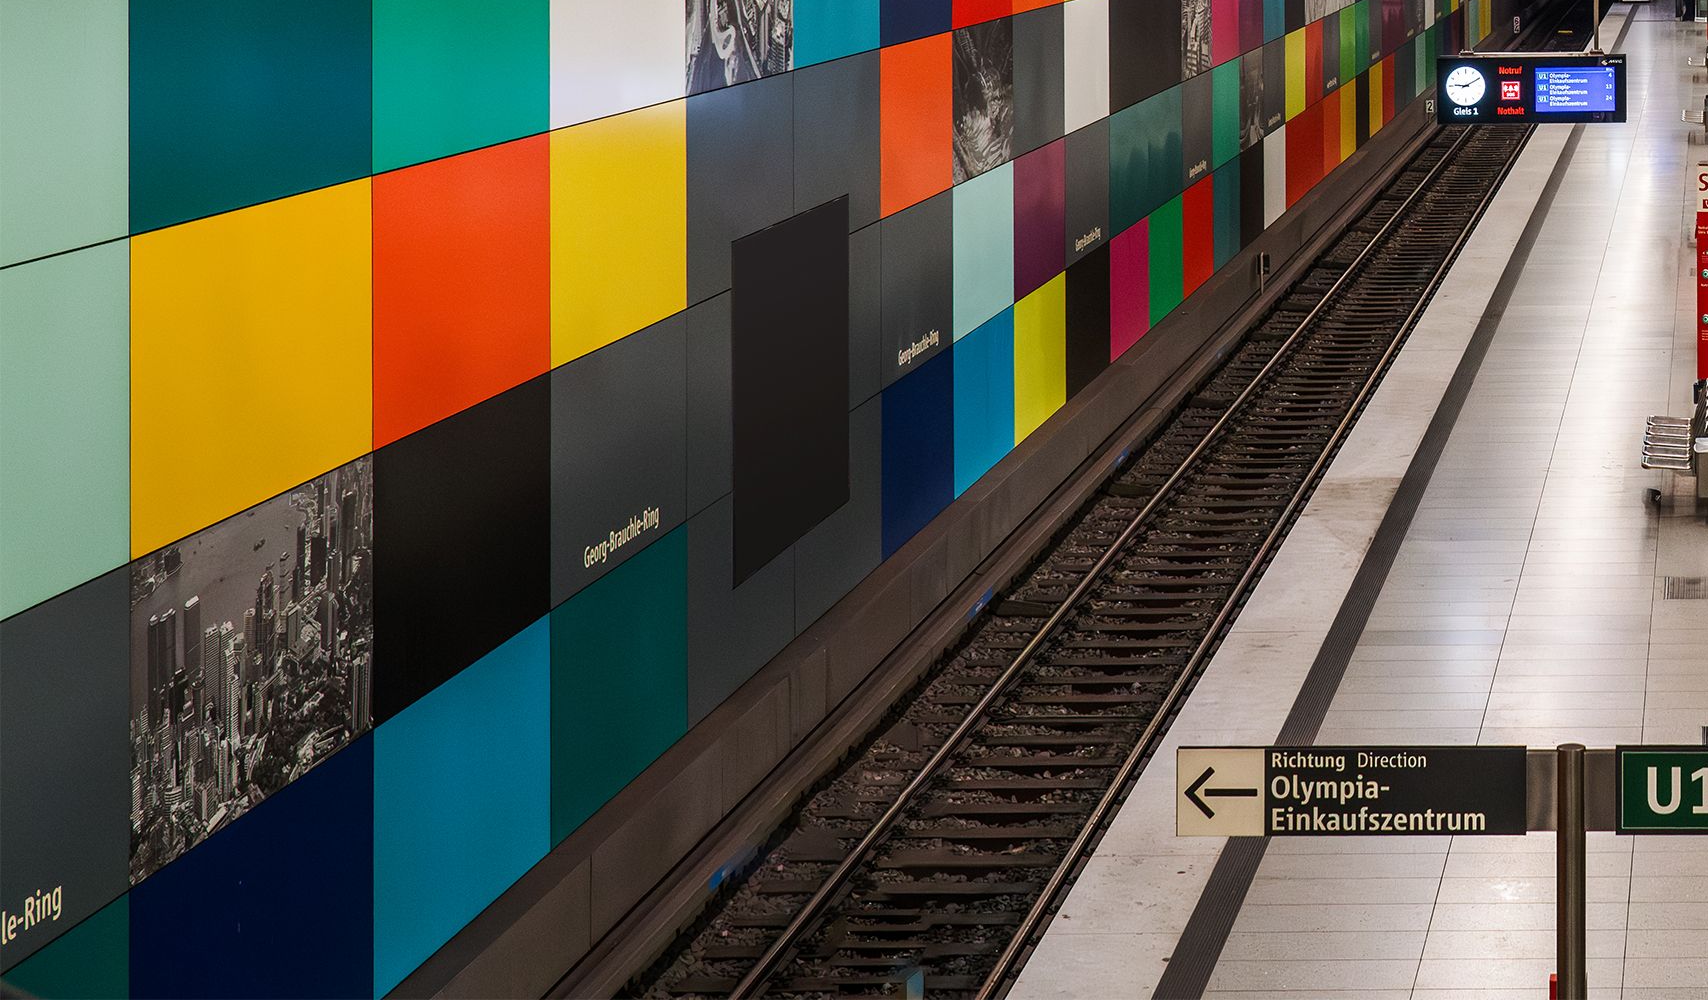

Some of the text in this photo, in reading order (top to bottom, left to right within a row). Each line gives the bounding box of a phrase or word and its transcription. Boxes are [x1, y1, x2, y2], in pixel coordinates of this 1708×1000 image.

[1498, 65, 1522, 74] Notruf
[1427, 101, 1433, 111] 2
[1453, 107, 1479, 116] Gleis 1
[1497, 106, 1525, 115] Nothalt
[584, 506, 660, 569] Georg-Brauchle-Ring
[1271, 751, 1427, 772] Richtung Direction
[1271, 773, 1391, 805] Olympia-
[1271, 806, 1487, 831] Einkaufszentrum
[1, 885, 62, 946] le-Ring
